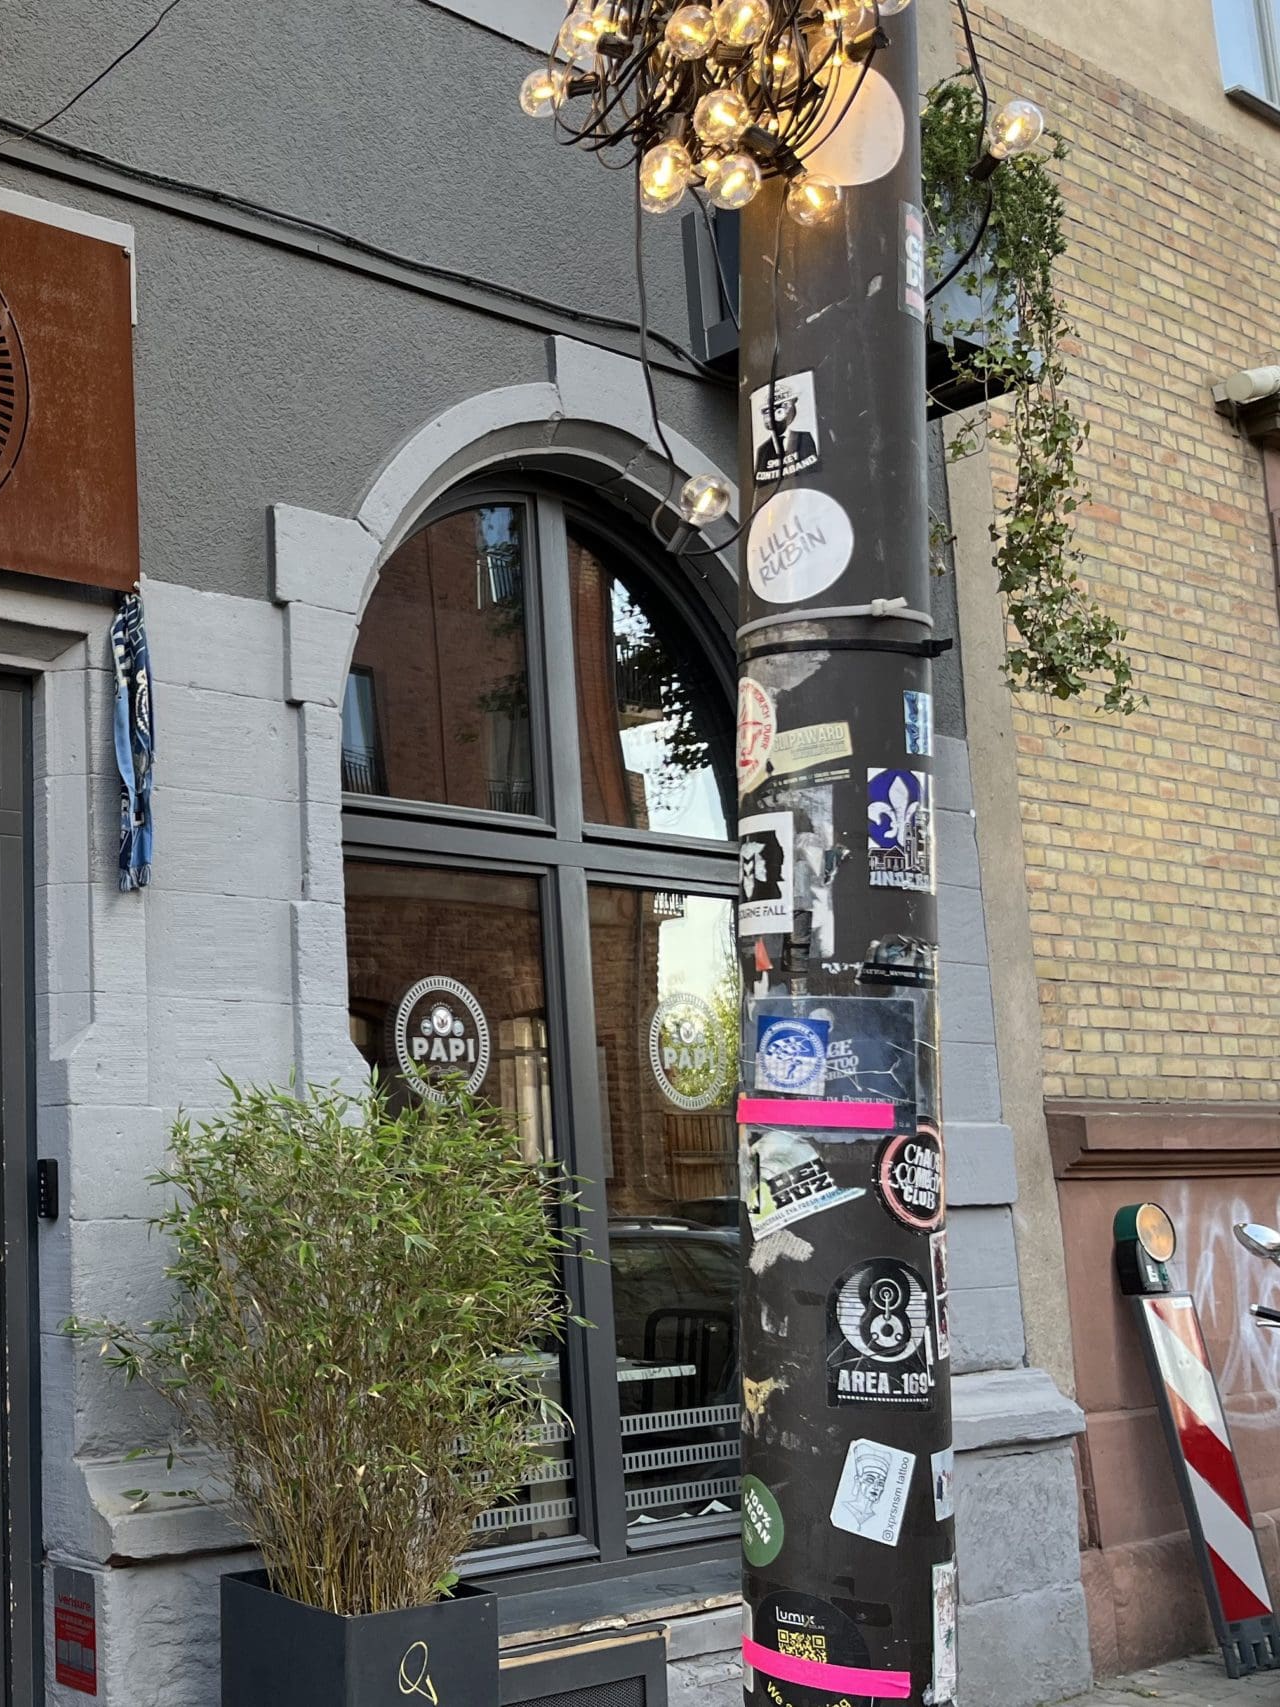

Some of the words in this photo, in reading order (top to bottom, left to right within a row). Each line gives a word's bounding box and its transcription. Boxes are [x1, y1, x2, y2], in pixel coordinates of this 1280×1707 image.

[760, 514, 803, 563] LILLI
[760, 526, 826, 587] RUBIN
[763, 904, 787, 917] FALL
[412, 1036, 476, 1063] PAPI
[903, 1186, 936, 1210] CLUB
[744, 1492, 771, 1545] VEGAN
[750, 1488, 772, 1529] 100%
[767, 1681, 783, 1705] We
